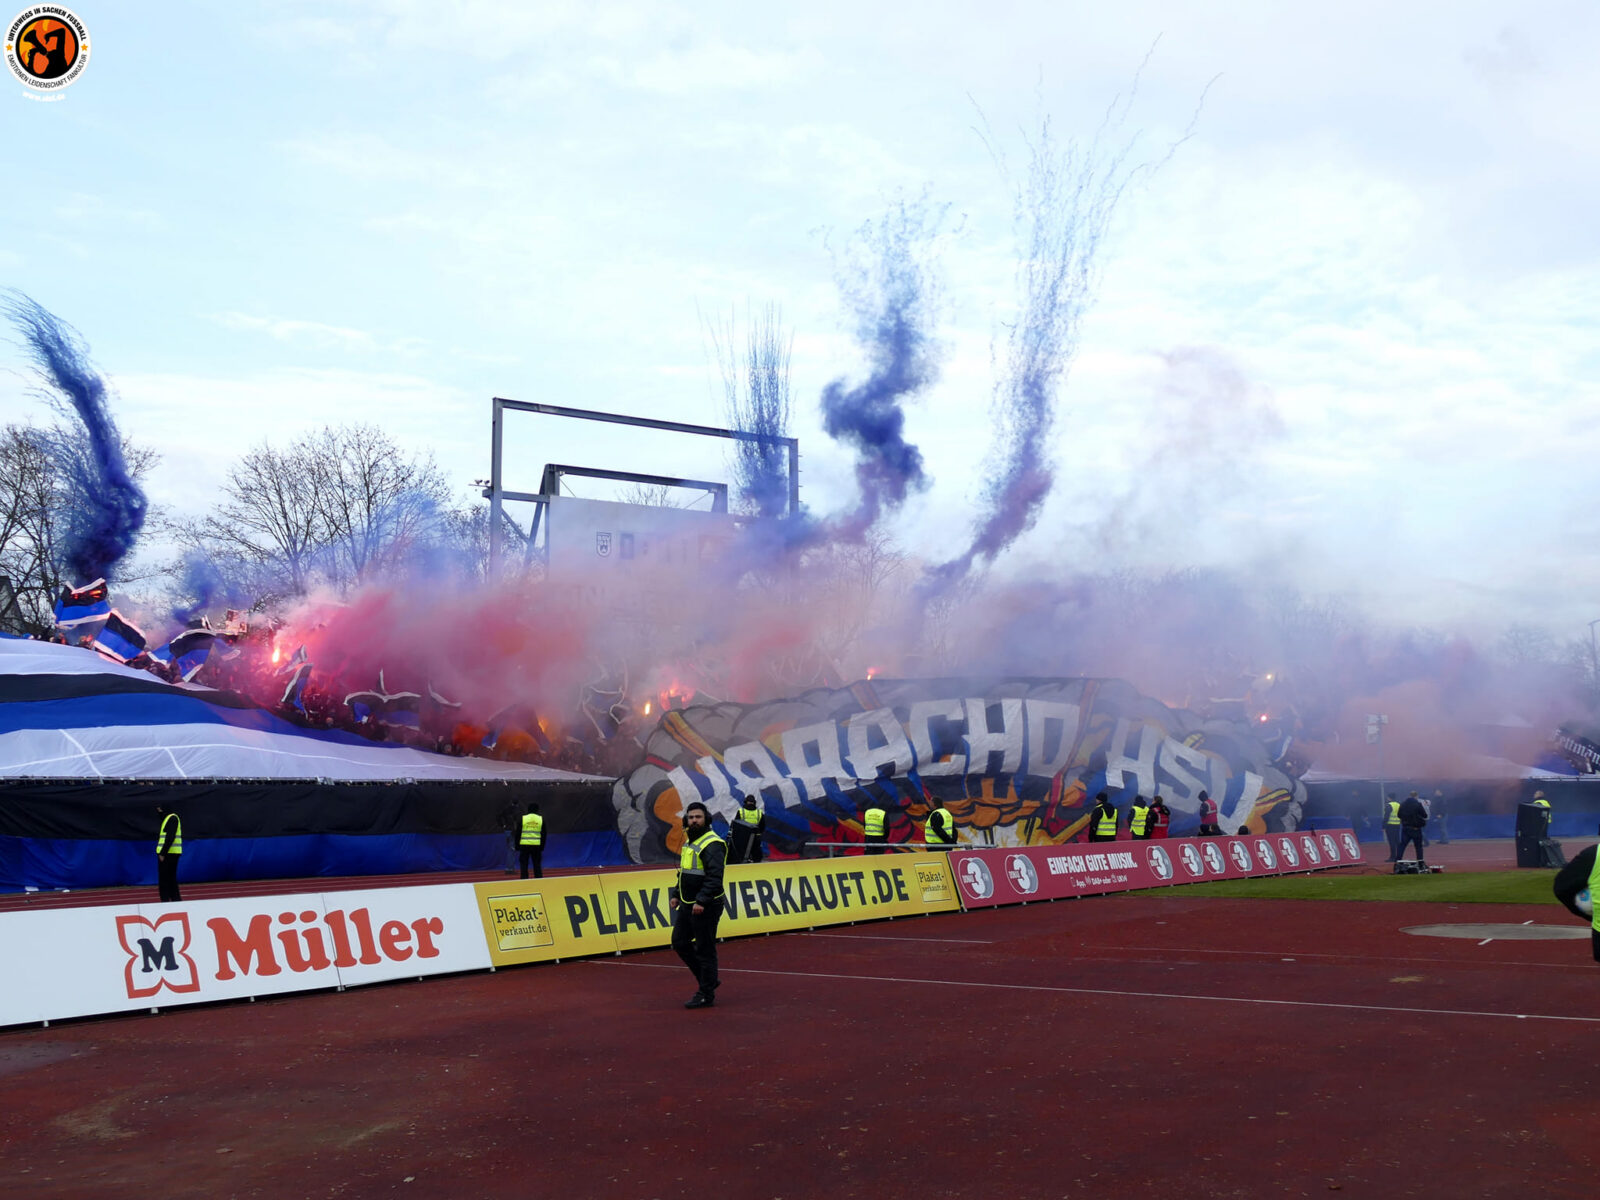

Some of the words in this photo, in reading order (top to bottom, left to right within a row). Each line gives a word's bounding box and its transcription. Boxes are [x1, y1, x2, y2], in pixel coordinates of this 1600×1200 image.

[918, 872, 945, 883] Plakat-
[967, 862, 986, 894] 3
[1013, 858, 1031, 889] 3
[1047, 856, 1087, 875] EINFACH
[1085, 854, 1109, 872] GUTE
[1106, 852, 1138, 869] MUSIK.
[494, 907, 543, 923] Plakat-
[564, 868, 910, 938] PLAKVERKAUFT.DE
[206, 908, 444, 981] Müller
[500, 924, 547, 936] verkauft.de
[137, 936, 179, 973] M
